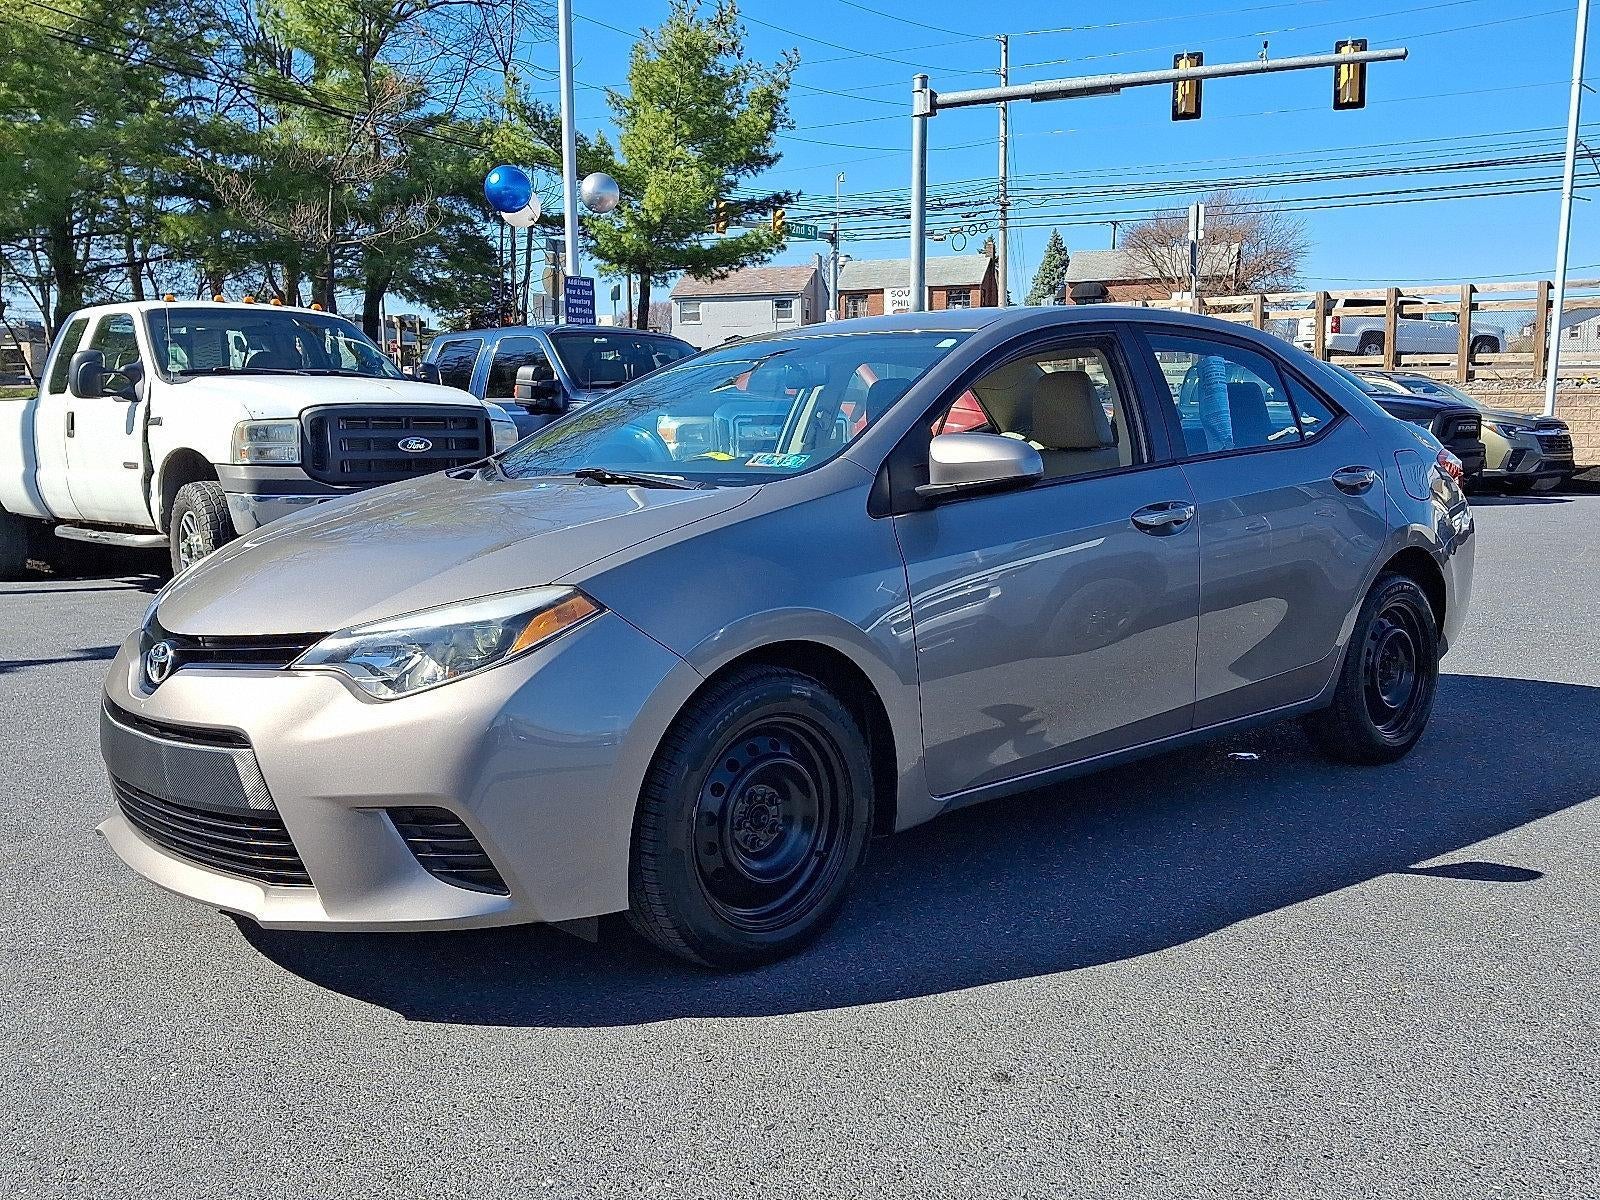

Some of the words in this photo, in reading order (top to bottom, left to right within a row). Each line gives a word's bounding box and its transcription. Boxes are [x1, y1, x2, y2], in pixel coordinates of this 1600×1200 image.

[808, 226, 815, 236] St
[569, 297, 590, 306] Inventory
[568, 316, 585, 324] Storage
[407, 440, 425, 449] Ford
